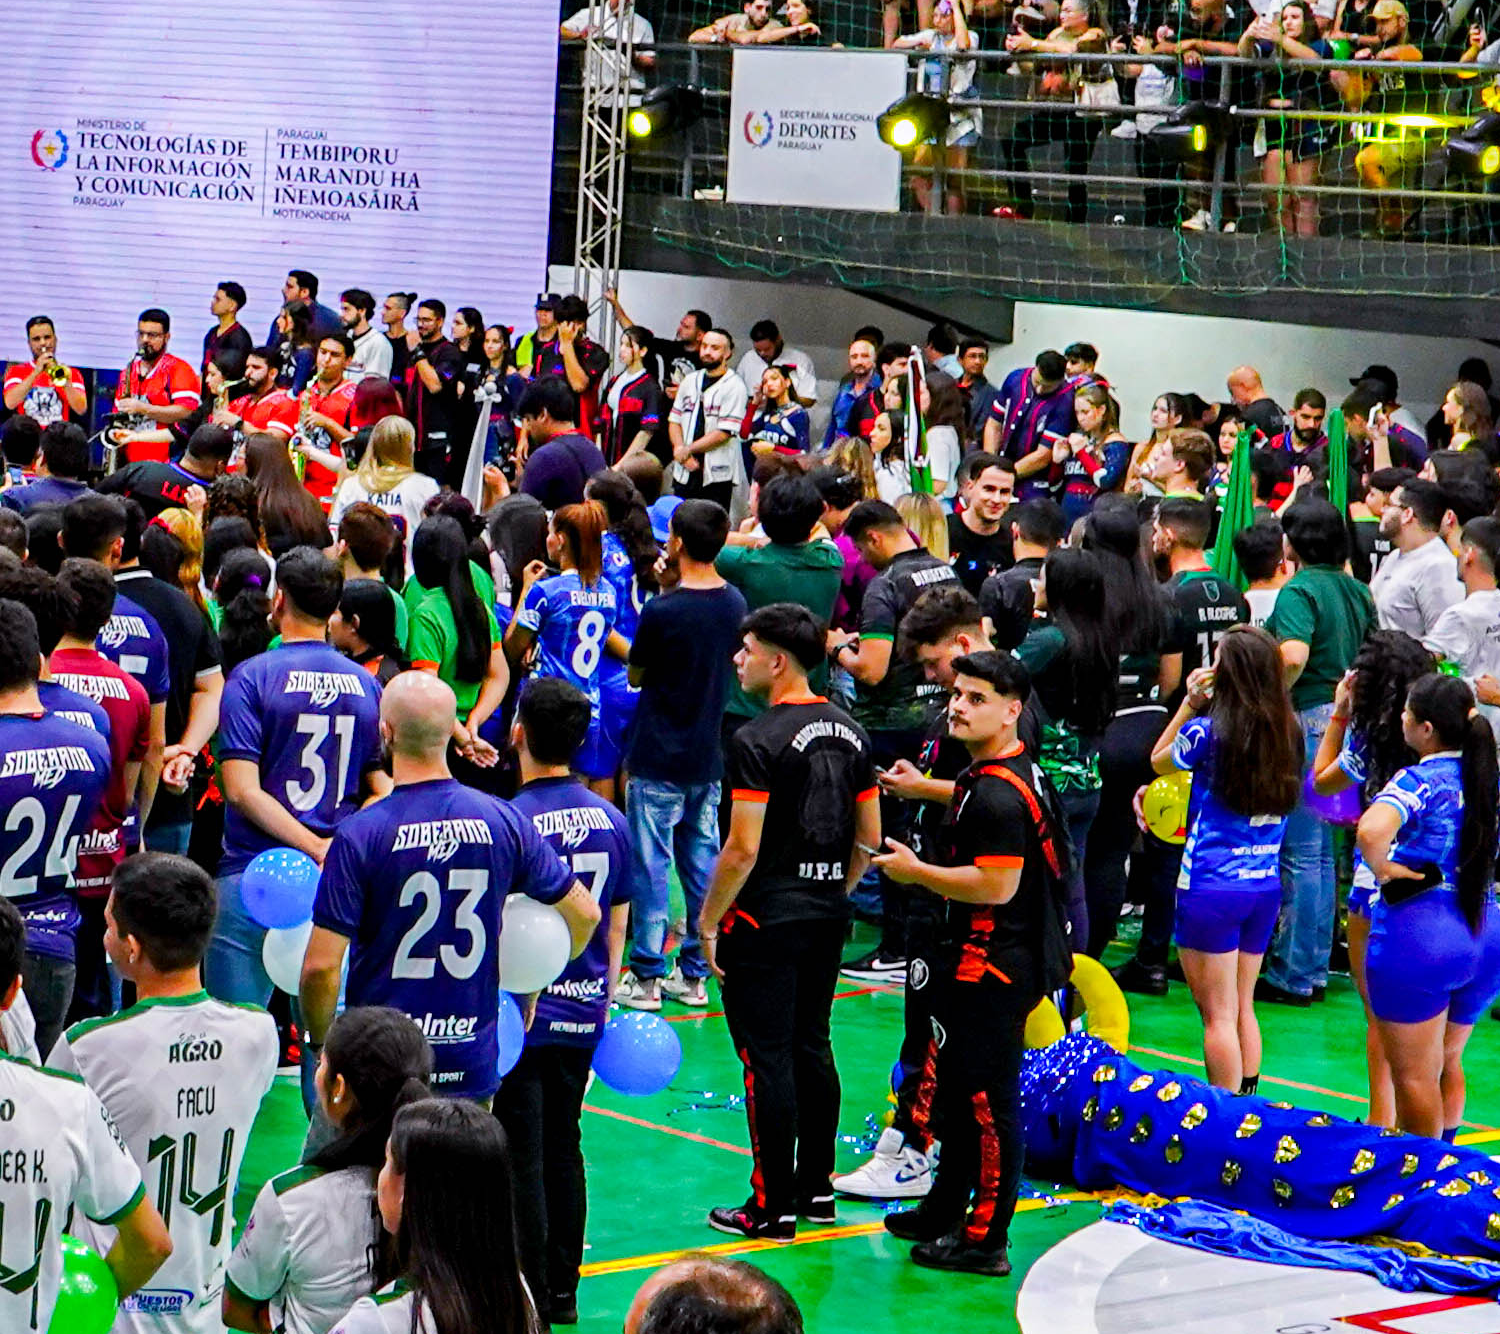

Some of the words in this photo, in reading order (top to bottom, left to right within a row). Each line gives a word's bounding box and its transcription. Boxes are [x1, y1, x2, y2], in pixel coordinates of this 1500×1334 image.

[76, 119, 132, 130] MINISTERIO
[133, 122, 146, 131] DE
[779, 122, 856, 141] DEPORTES
[77, 132, 216, 157] TECNOLOGÍAS
[221, 141, 248, 158] DE
[277, 143, 399, 165] TEMBIPORU
[778, 140, 823, 151] PARAGUAY
[76, 153, 100, 170] LA
[105, 155, 253, 179] INFORMACIÓN
[275, 165, 385, 187] MARANDU
[393, 171, 421, 189] HA
[74, 176, 89, 192] Y
[91, 177, 255, 201] COMUNICACIÓN
[73, 197, 125, 209] PARAGUAY
[367, 490, 402, 507] KATIA
[572, 610, 605, 679] 8
[284, 670, 366, 697] SOBERANA
[309, 688, 339, 707] MED
[0, 746, 96, 777] SOBERANA
[286, 714, 356, 812] 31
[32, 768, 66, 787] MED
[533, 807, 613, 835] SOBERANA
[0, 795, 82, 897] 24
[392, 818, 494, 853] SOBERANA
[562, 825, 590, 848] MED
[427, 838, 459, 863] MED
[391, 869, 489, 980] 23
[168, 1039, 222, 1064] AGRO
[177, 1086, 215, 1119] FACU
[33, 1149, 48, 1184] K.
[148, 1128, 235, 1247] 14
